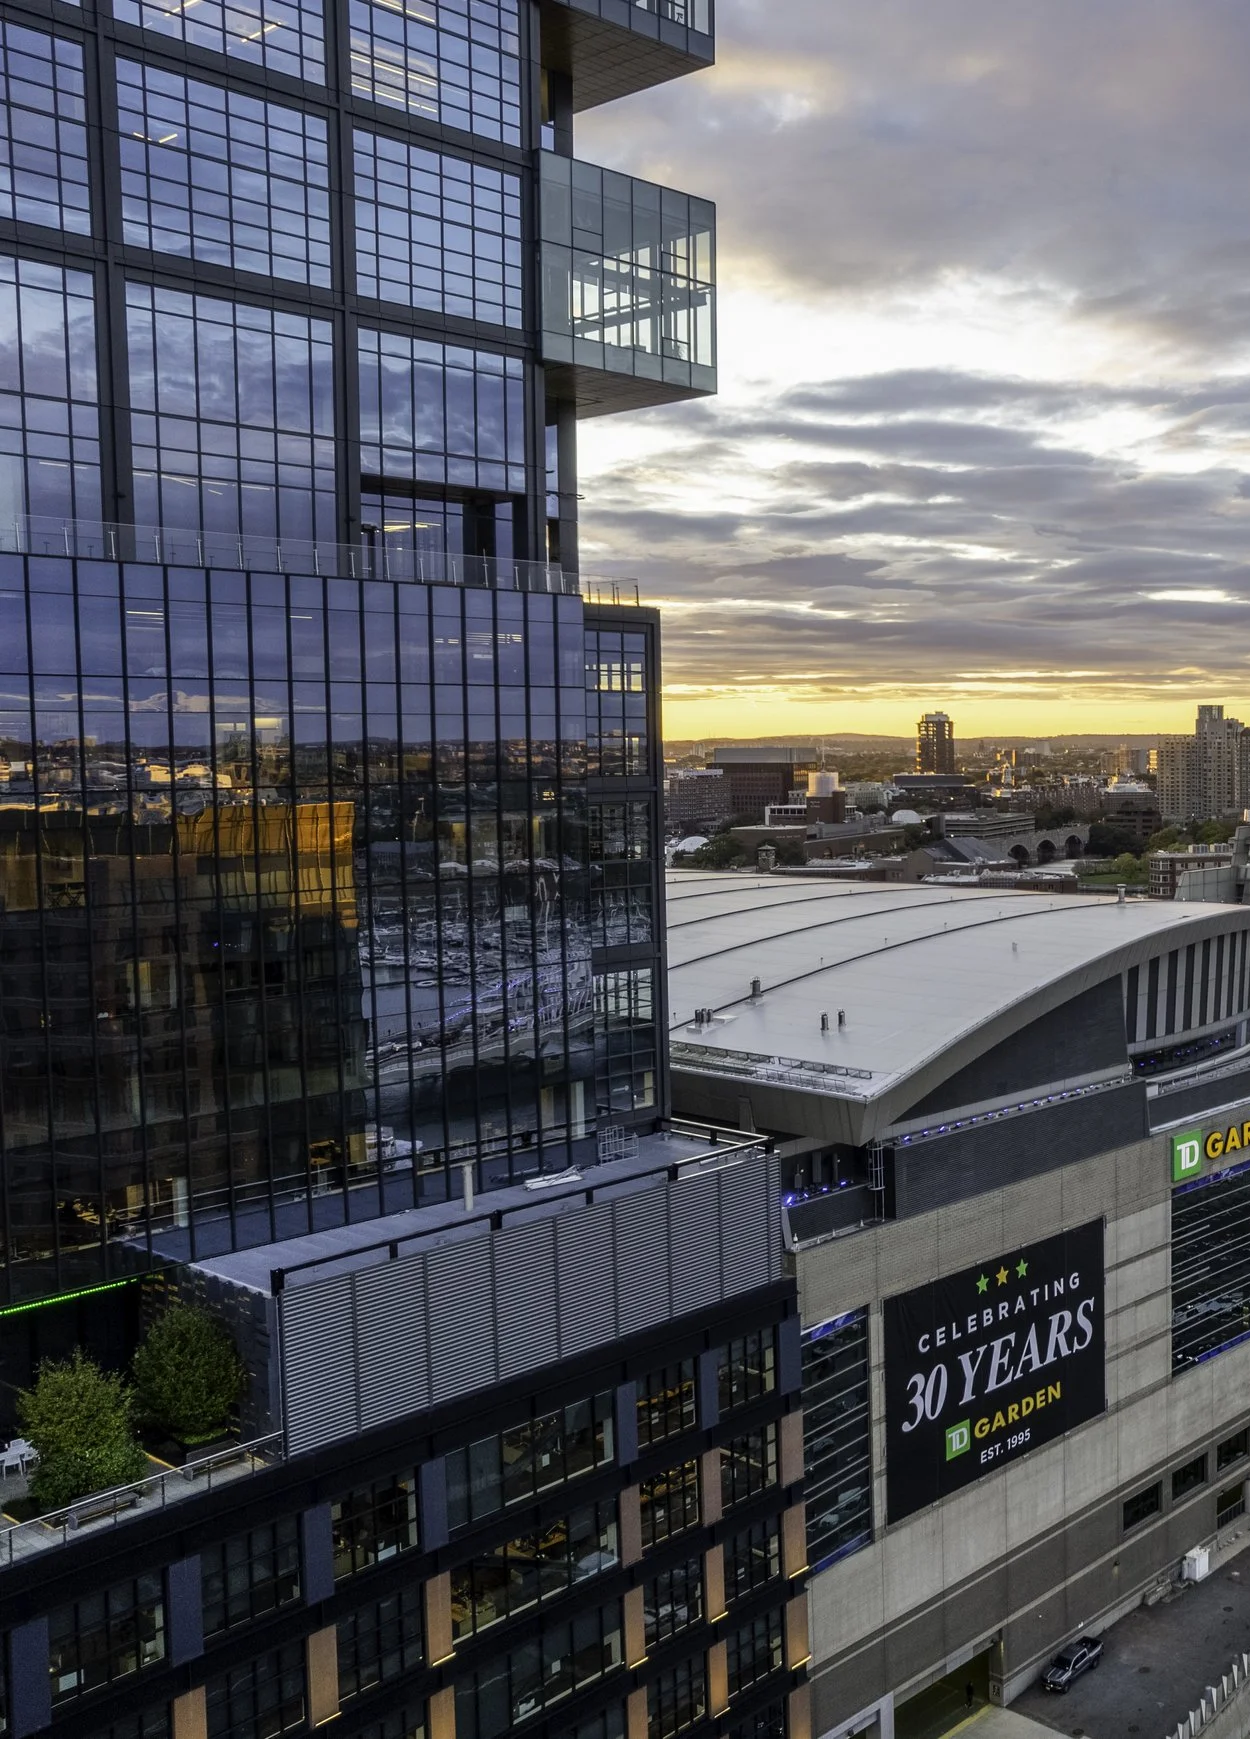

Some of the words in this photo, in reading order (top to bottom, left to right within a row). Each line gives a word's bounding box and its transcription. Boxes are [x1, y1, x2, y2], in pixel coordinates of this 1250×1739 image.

[1176, 1140, 1200, 1170] TD
[918, 1272, 1080, 1353] CELEBRATING
[901, 1363, 948, 1433] 30
[957, 1297, 1095, 1406] YEARS
[947, 1427, 968, 1452] TD
[974, 1381, 1062, 1439] GARDEN
[980, 1445, 1004, 1464] EST.
[1006, 1428, 1031, 1451] 1995
